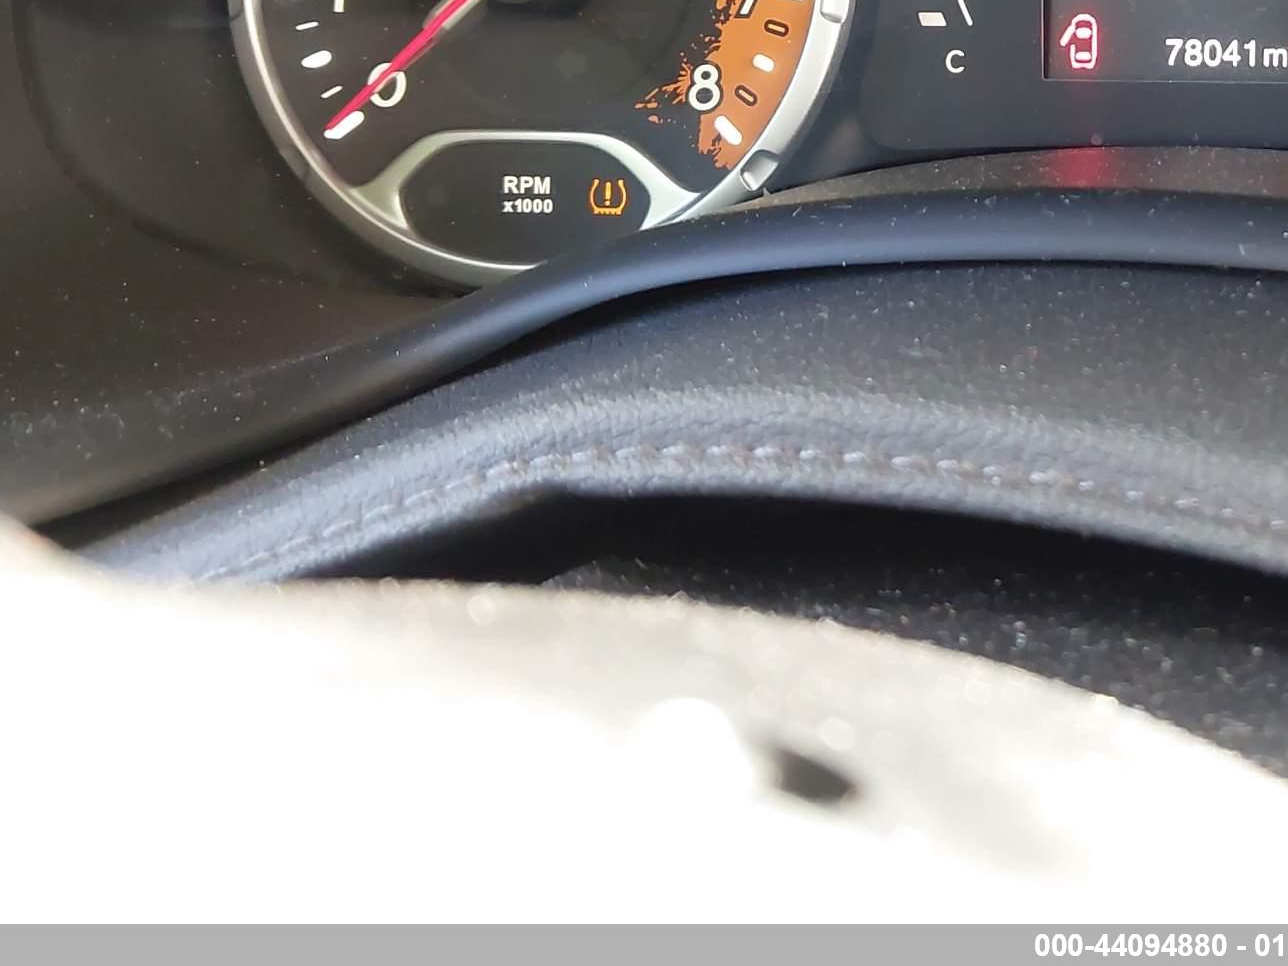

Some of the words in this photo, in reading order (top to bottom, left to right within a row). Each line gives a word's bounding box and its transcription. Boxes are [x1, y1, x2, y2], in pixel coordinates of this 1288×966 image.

[945, 49, 965, 74] C
[367, 61, 408, 108] 0
[687, 63, 723, 112] 8
[503, 175, 551, 195] RPM
[503, 198, 553, 214] x1000
